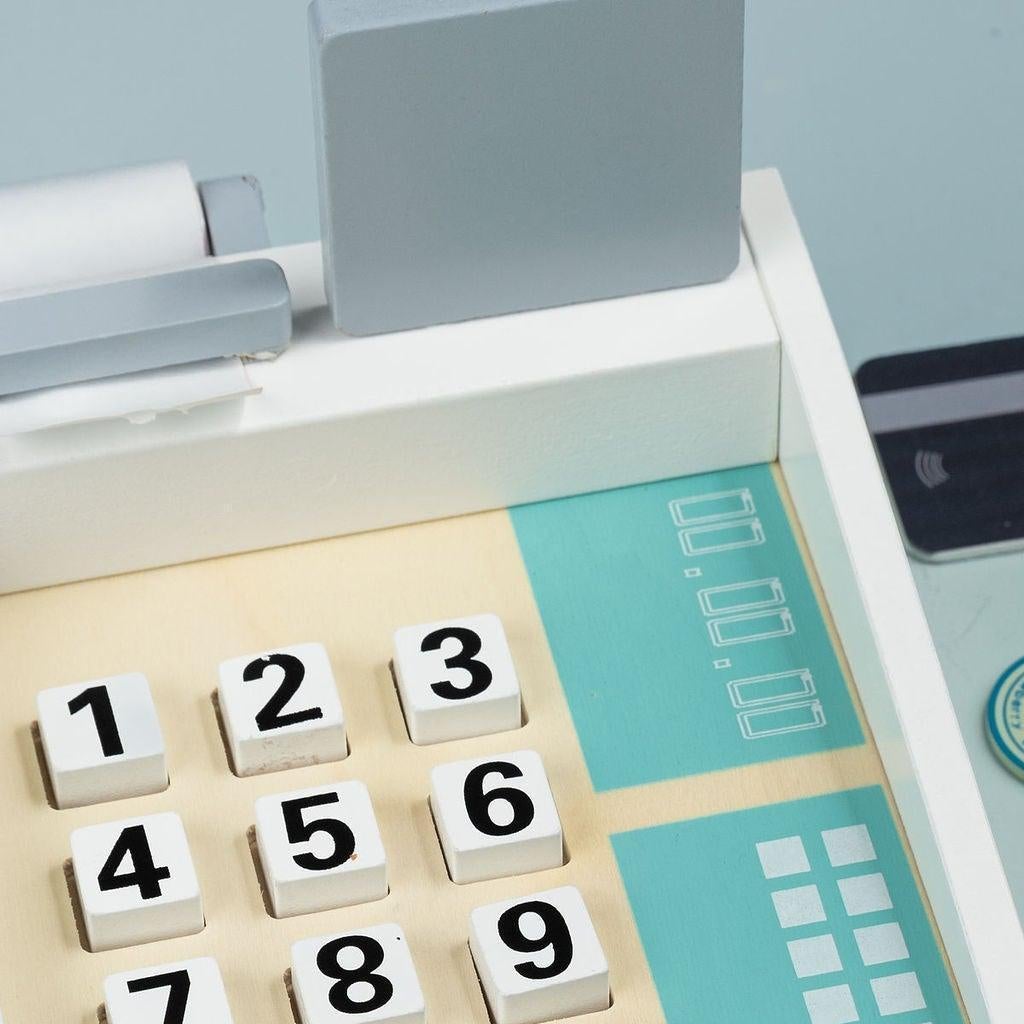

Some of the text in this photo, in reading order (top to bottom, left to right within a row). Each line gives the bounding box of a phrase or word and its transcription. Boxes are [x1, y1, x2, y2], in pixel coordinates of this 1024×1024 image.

[242, 653, 324, 732] 2
[420, 627, 493, 700] 3
[67, 685, 124, 758] 1
[281, 791, 356, 871] 5
[463, 761, 535, 837] 6
[97, 824, 171, 900] 4
[316, 935, 394, 1014] 8
[497, 900, 573, 980] 9
